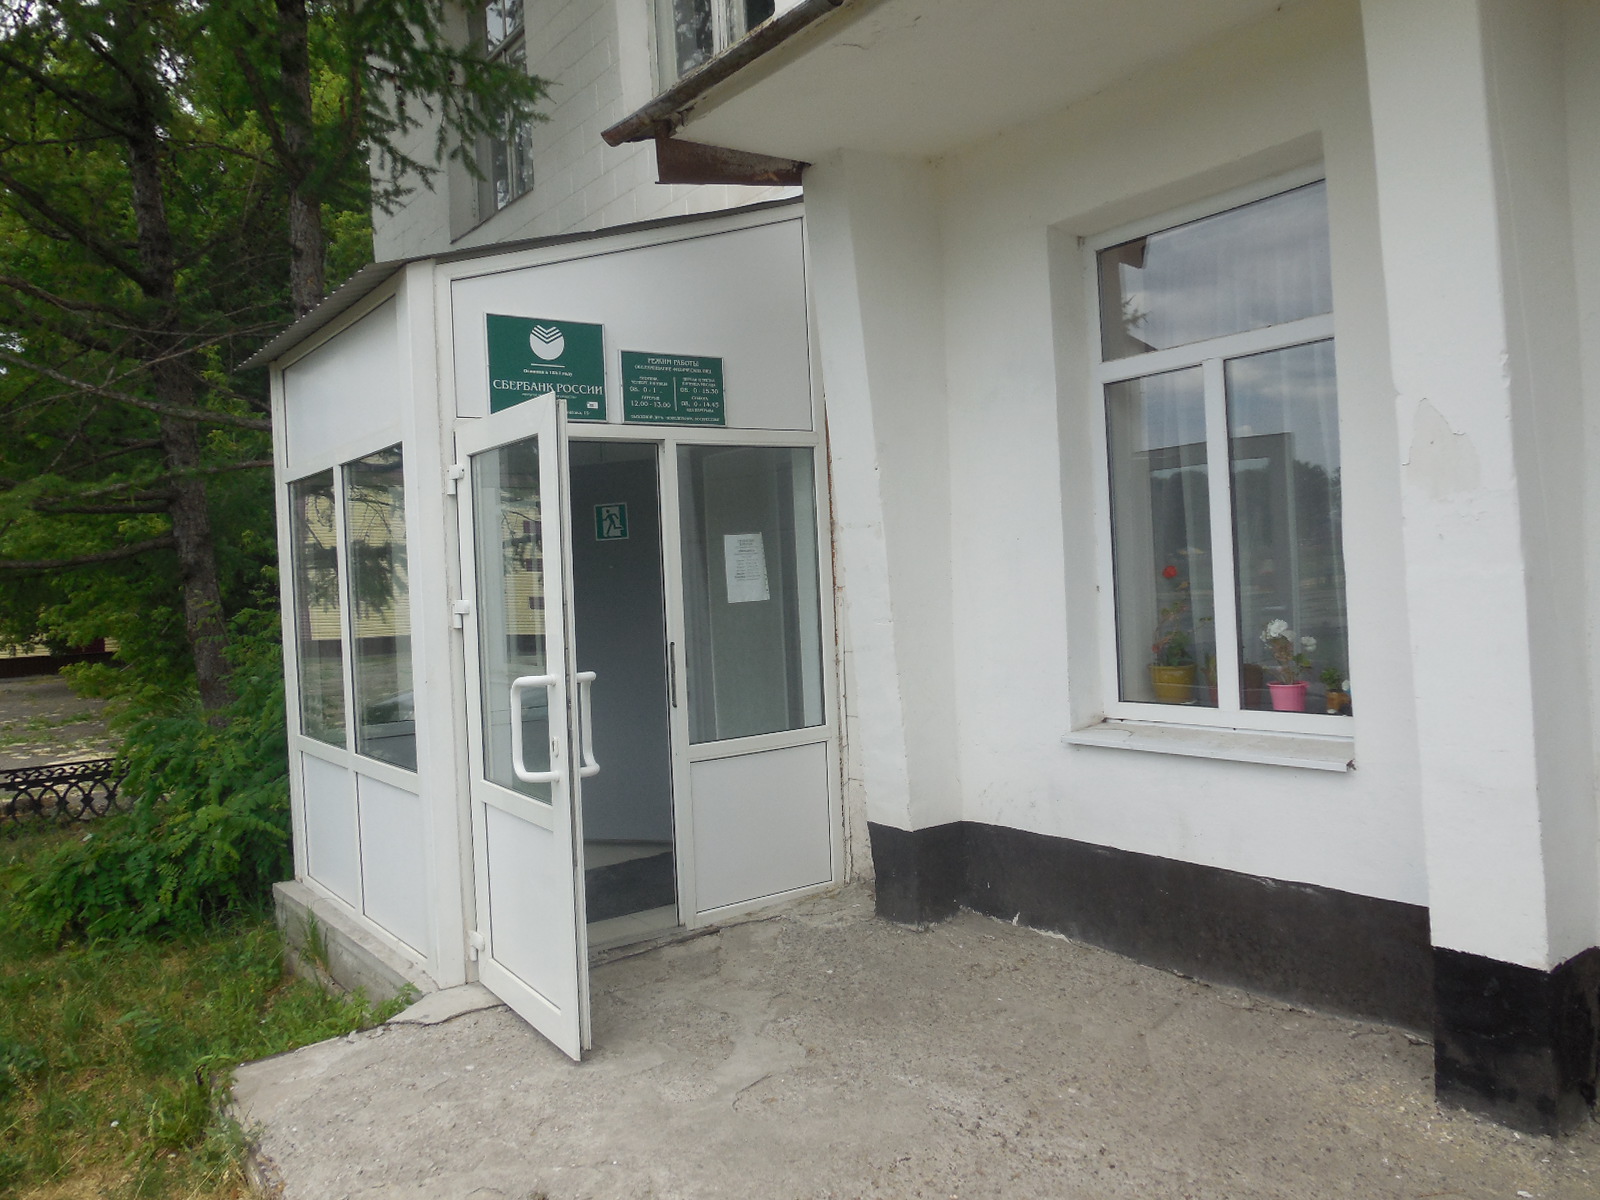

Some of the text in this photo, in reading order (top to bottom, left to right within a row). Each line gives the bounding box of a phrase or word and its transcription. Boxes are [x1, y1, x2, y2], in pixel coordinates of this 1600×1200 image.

[673, 359, 699, 367] РАБОТЫ
[493, 380, 603, 395] СБЕРБАНК РОССИИ
